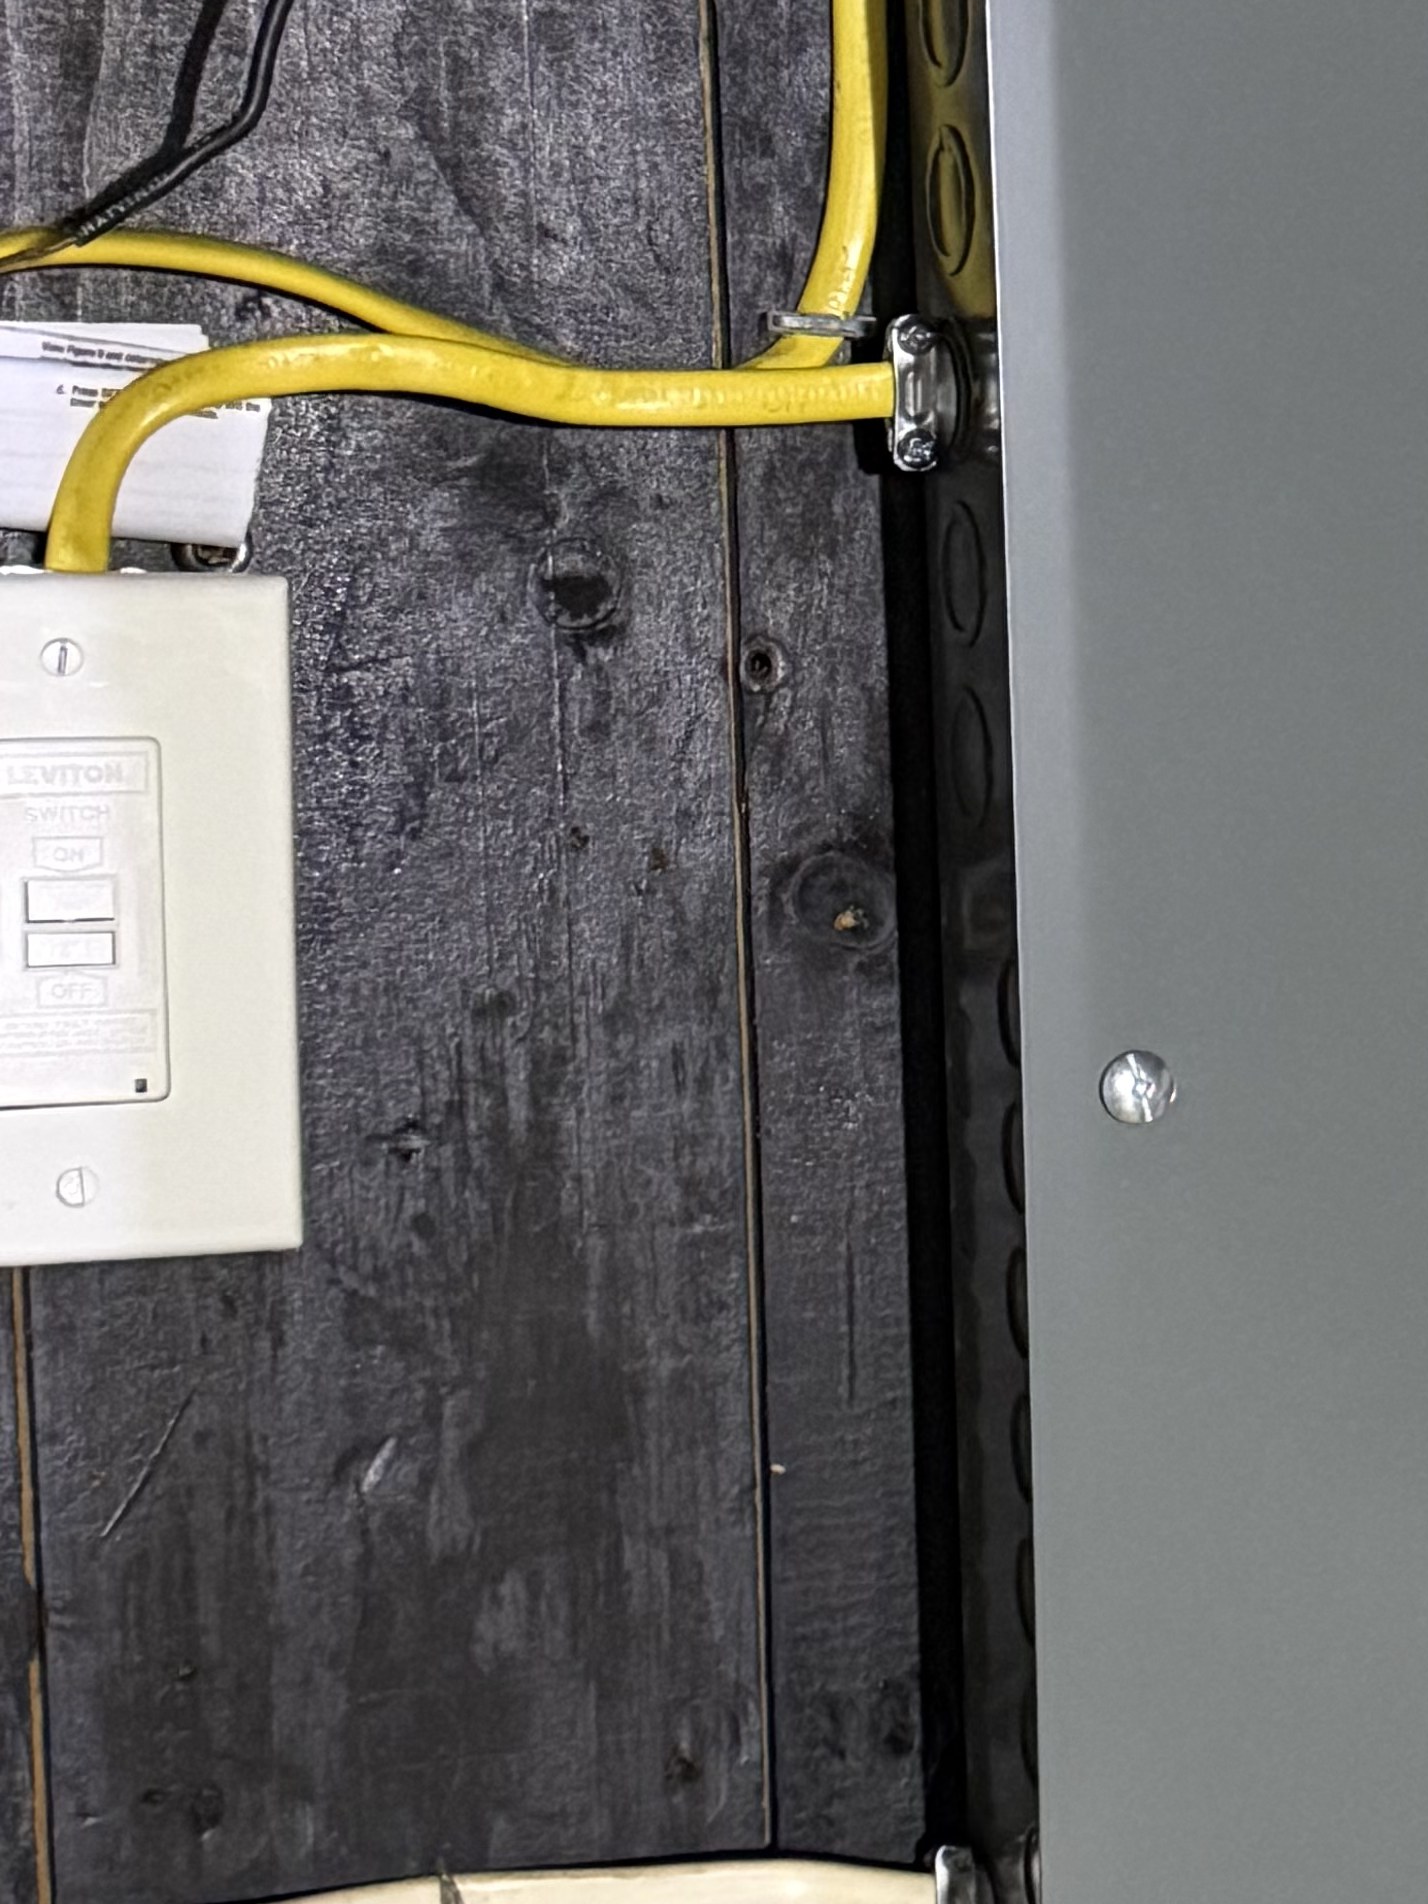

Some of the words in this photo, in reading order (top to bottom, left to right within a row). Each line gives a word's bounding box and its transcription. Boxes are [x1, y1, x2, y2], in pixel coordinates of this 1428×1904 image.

[6, 763, 124, 786] LEVITON
[24, 804, 111, 822] SWITCH
[51, 982, 93, 999] OFF
